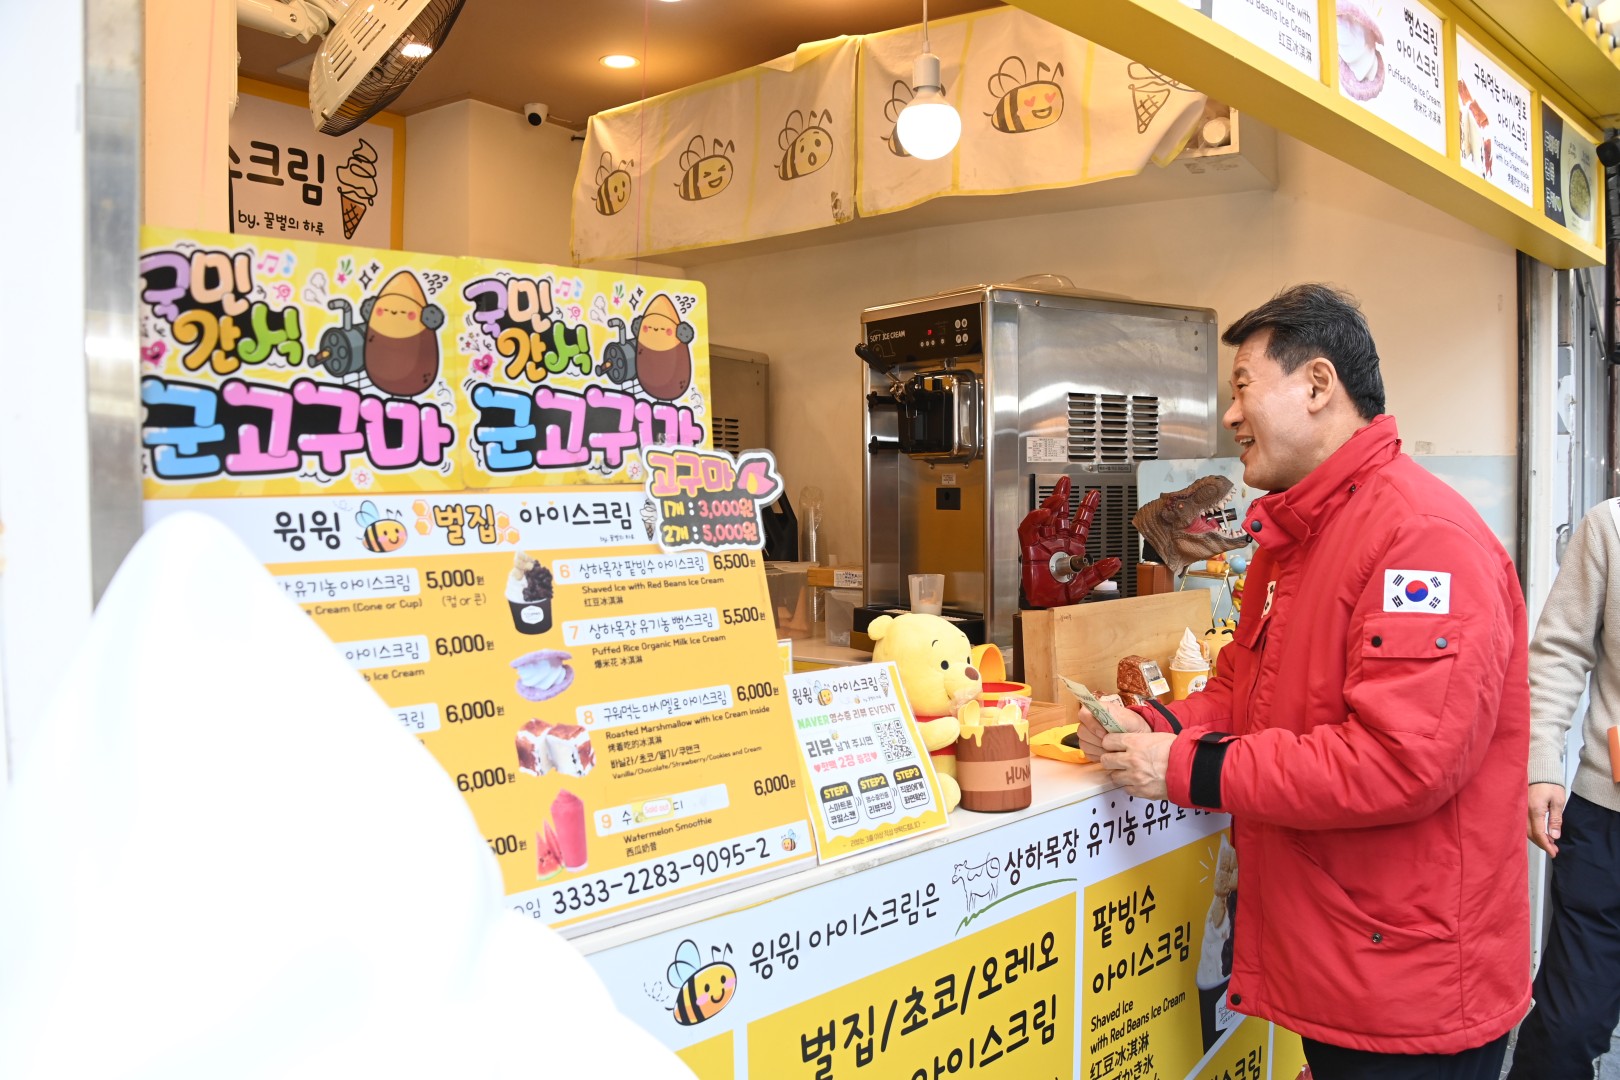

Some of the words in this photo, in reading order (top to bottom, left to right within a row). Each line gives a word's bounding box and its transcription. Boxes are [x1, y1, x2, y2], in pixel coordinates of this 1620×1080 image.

[1279, 10, 1289, 28] Ice
[1290, 18, 1312, 43] Cream
[1396, 39, 1439, 89] 아이스크림
[1406, 76, 1417, 92] Rice
[1425, 89, 1441, 109] Cream
[1473, 63, 1500, 103] 구워먹는
[1497, 113, 1528, 151] 아이스크림
[238, 210, 260, 229] by.
[264, 211, 299, 230] 꿀벌의
[302, 219, 325, 236] 하루
[463, 277, 553, 340] 국민
[171, 300, 303, 376] 간식
[870, 333, 881, 343] SOFT
[882, 331, 890, 340] ICE
[889, 329, 906, 340] CREAM
[497, 319, 593, 383] 간식
[139, 375, 454, 480] 군고구마
[471, 382, 704, 473] 군고구마
[647, 449, 737, 498] 고구마
[698, 497, 755, 519] 3,000원
[273, 510, 341, 551] 윙윙
[433, 503, 497, 546] 벌집
[519, 501, 632, 530] 아이스크림
[702, 521, 758, 543] 5,000원
[560, 563, 571, 579] 6
[579, 561, 623, 579] 상하목장
[624, 560, 656, 577] 팥빙수
[657, 556, 704, 572] 아이스크림
[712, 553, 757, 571] 6,500원
[294, 579, 337, 598] 유기농
[340, 574, 411, 593] 아이스크림
[425, 568, 485, 591] 5,000원
[582, 584, 613, 595] Shaved
[614, 583, 626, 592] Ice
[628, 581, 645, 591] with
[647, 580, 662, 589] Red
[663, 579, 687, 588] Beans
[688, 578, 699, 586] Ice
[700, 577, 725, 585] Cream
[315, 605, 351, 615] Cream
[722, 606, 766, 626] 5,500원
[568, 625, 579, 640] 7
[589, 620, 637, 640] 상하목장
[639, 617, 670, 633] 유기농
[345, 641, 419, 661] 아이스크림
[435, 633, 495, 656] 6,000원
[592, 645, 622, 656] Puffed
[622, 643, 640, 653] Rice
[641, 640, 672, 652] Organic
[673, 638, 688, 646] Milk
[702, 634, 727, 643] Cream
[373, 671, 389, 681] Ice
[391, 668, 425, 679] Cream
[736, 681, 780, 702] 6,000원
[792, 687, 813, 706] 윙윙
[832, 676, 878, 693] 아이스크림
[445, 699, 505, 724] 6,000원
[583, 710, 594, 725] 8
[603, 704, 641, 722] 구워먹는
[642, 697, 682, 715] 마시멜로
[683, 690, 727, 706] 아이스크림
[797, 714, 830, 730] NAVER
[852, 707, 868, 719] 리뷰
[868, 703, 896, 716] EVENT
[605, 727, 639, 740] Roasted
[640, 718, 692, 733] Marshmallow
[694, 715, 711, 725] with
[712, 713, 723, 722] Ice
[724, 710, 749, 720] Cream
[749, 705, 770, 716] inside
[805, 738, 834, 758] 리뷰
[852, 735, 874, 749] 주시면
[456, 767, 516, 792] 6,000원
[754, 774, 796, 796] 6,000원
[860, 775, 886, 790] STEP2
[895, 767, 920, 781] STEP3
[823, 784, 849, 799] STEP1
[828, 799, 853, 814] 스마트폰
[868, 801, 893, 814] 리뷰작성
[623, 826, 674, 844] Watermelon
[675, 816, 713, 832] Smoothie
[552, 837, 770, 914] 3333-2283-9095-2
[749, 930, 799, 980] 윙윙
[808, 882, 940, 948] 아이스크림은
[1004, 828, 1079, 885] 상하목장
[1086, 809, 1139, 858] 유기농
[1092, 885, 1156, 949] 팥빙수
[1092, 921, 1191, 994] 아이스크림
[800, 931, 1059, 1080] 벌집/초코/오레오
[1090, 1002, 1121, 1033] Shaved
[1122, 999, 1134, 1013] Ice
[1090, 1033, 1109, 1054] with
[1110, 1022, 1125, 1043] Red
[1126, 1011, 1150, 1035] Beans
[1150, 1005, 1162, 1019] Ice
[1162, 991, 1186, 1012] Cream
[910, 993, 1057, 1080] 아이스크림
[1089, 1030, 1150, 1079] 红豆冰淇淋
